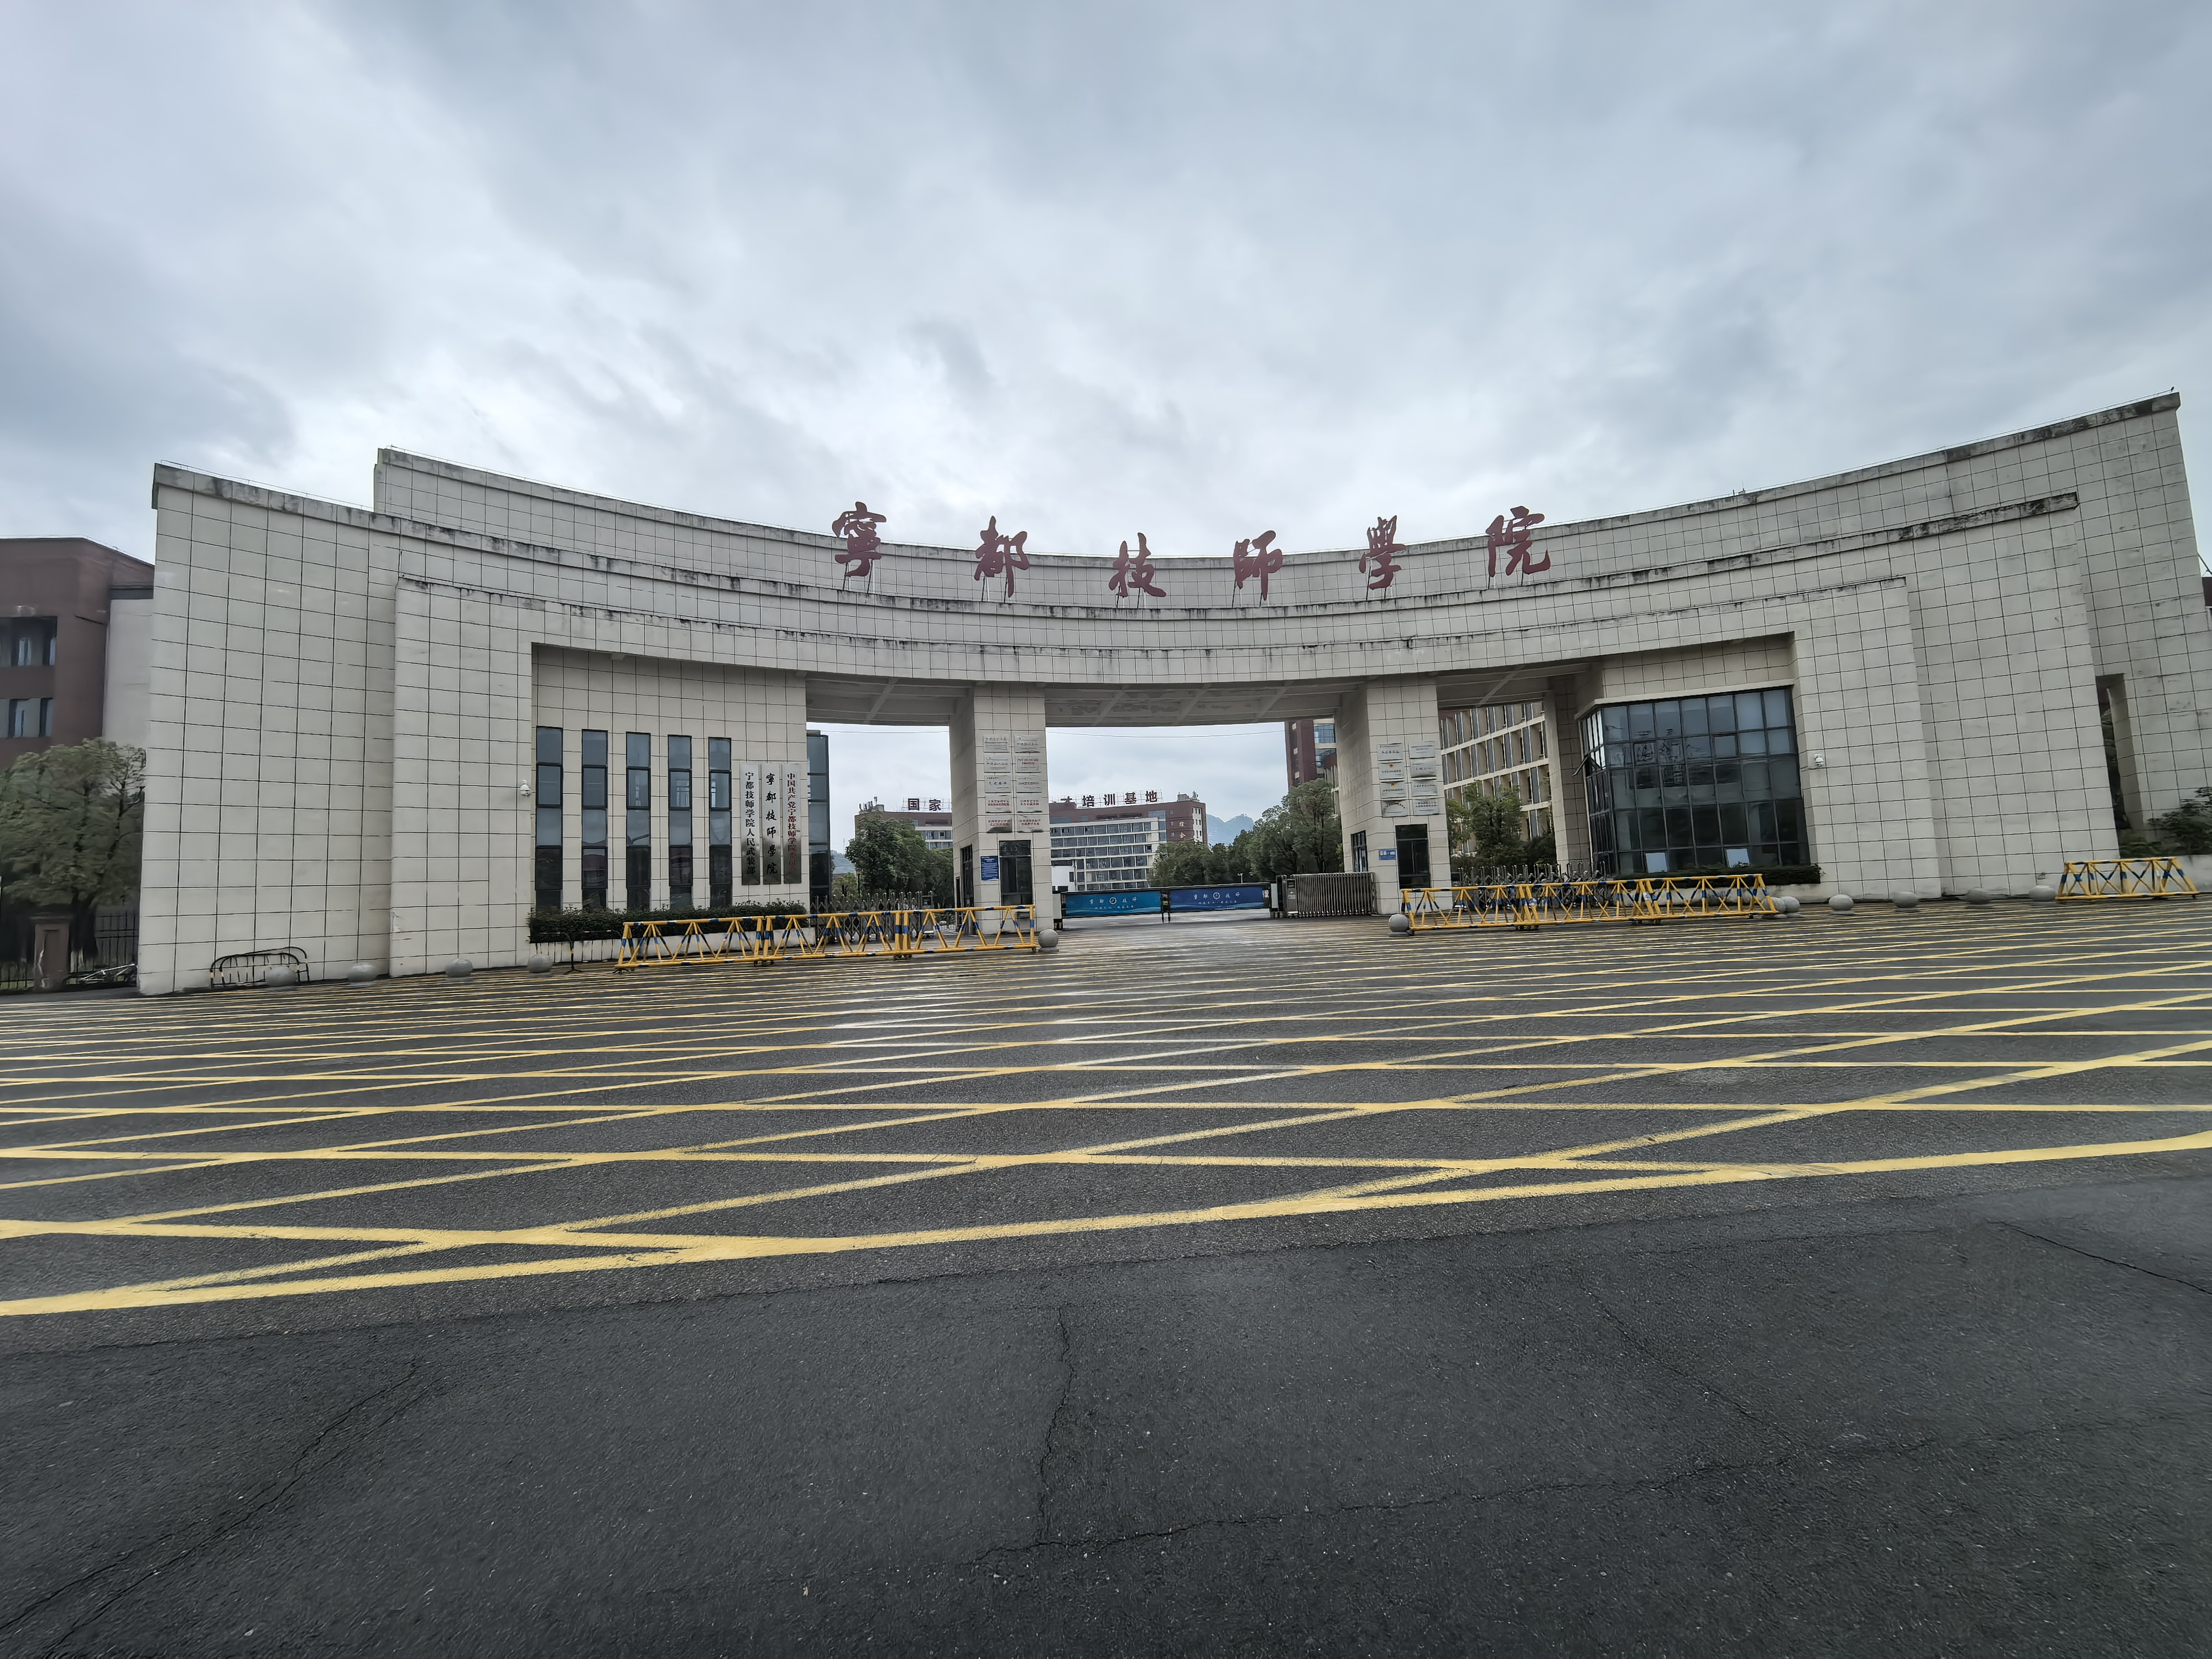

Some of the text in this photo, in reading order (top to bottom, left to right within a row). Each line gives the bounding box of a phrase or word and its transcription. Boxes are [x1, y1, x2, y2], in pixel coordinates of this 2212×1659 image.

[745, 772, 756, 875] 宁都技师学院人民武装部
[908, 798, 941, 811] 国家
